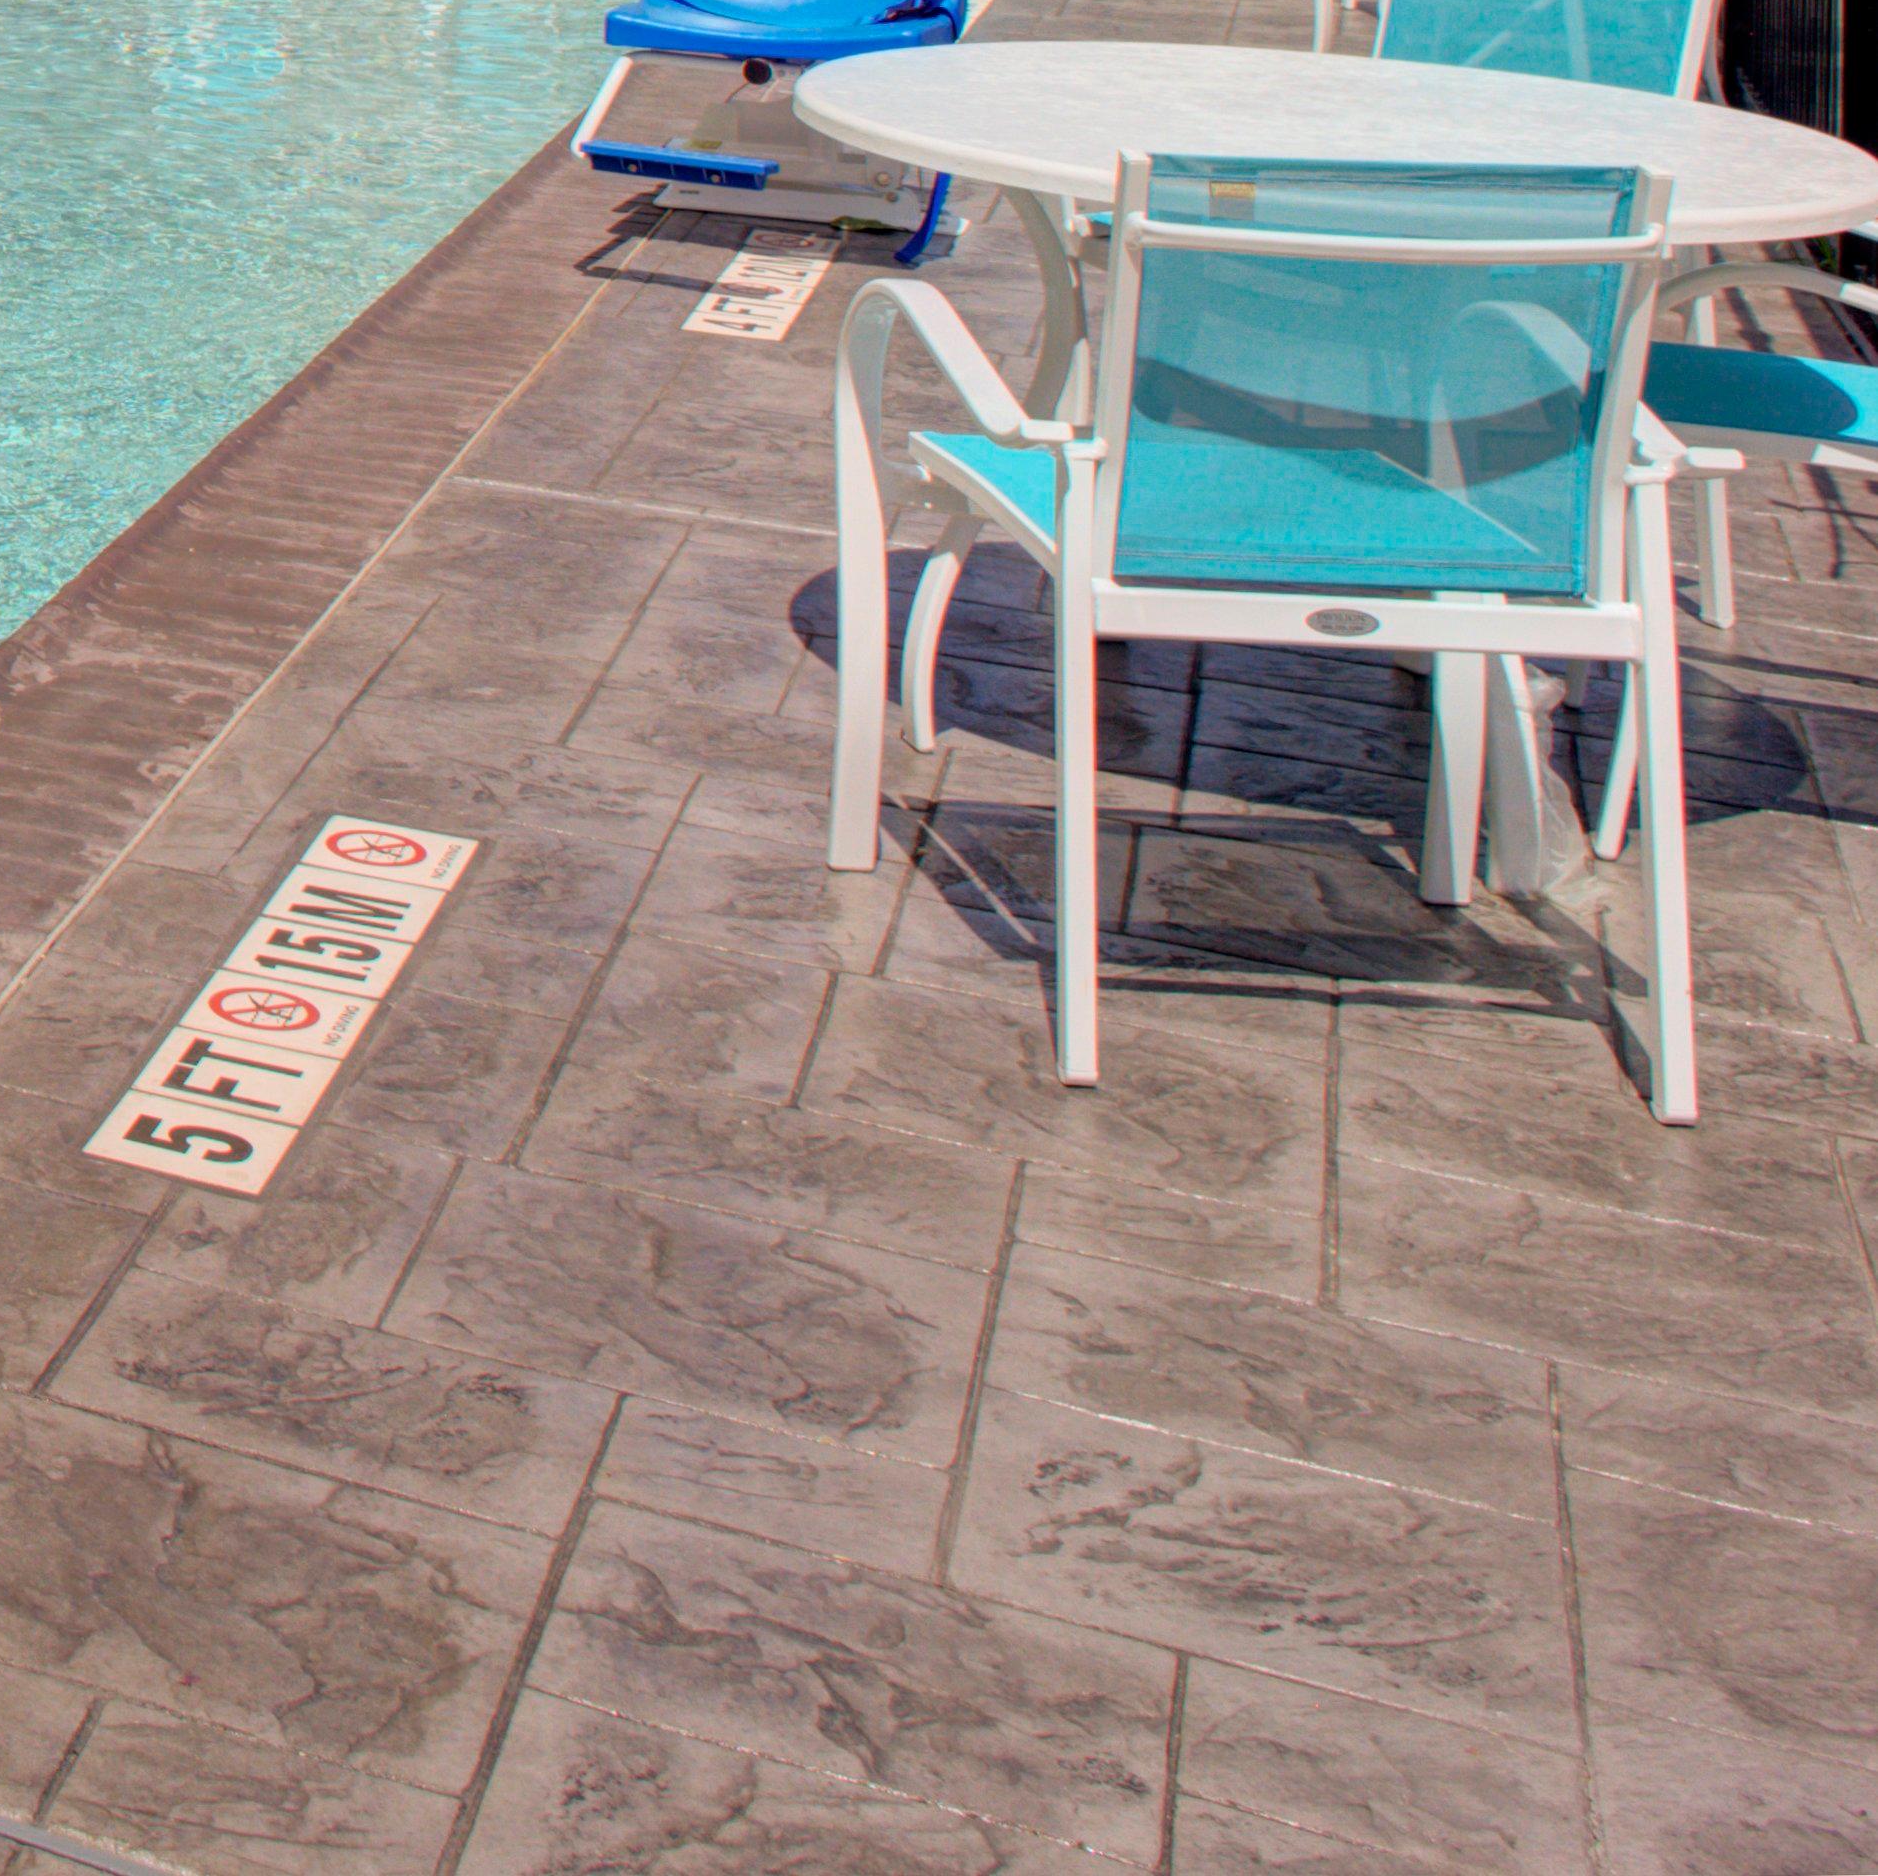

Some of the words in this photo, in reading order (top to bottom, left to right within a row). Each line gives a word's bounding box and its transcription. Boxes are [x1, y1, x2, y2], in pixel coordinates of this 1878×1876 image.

[702, 317, 772, 332] 4
[710, 296, 785, 319] FT
[289, 885, 412, 931] M
[323, 1031, 342, 1047] NO
[333, 1004, 361, 1033] DIVING
[161, 1038, 305, 1113] FT
[123, 1112, 254, 1164] 5
